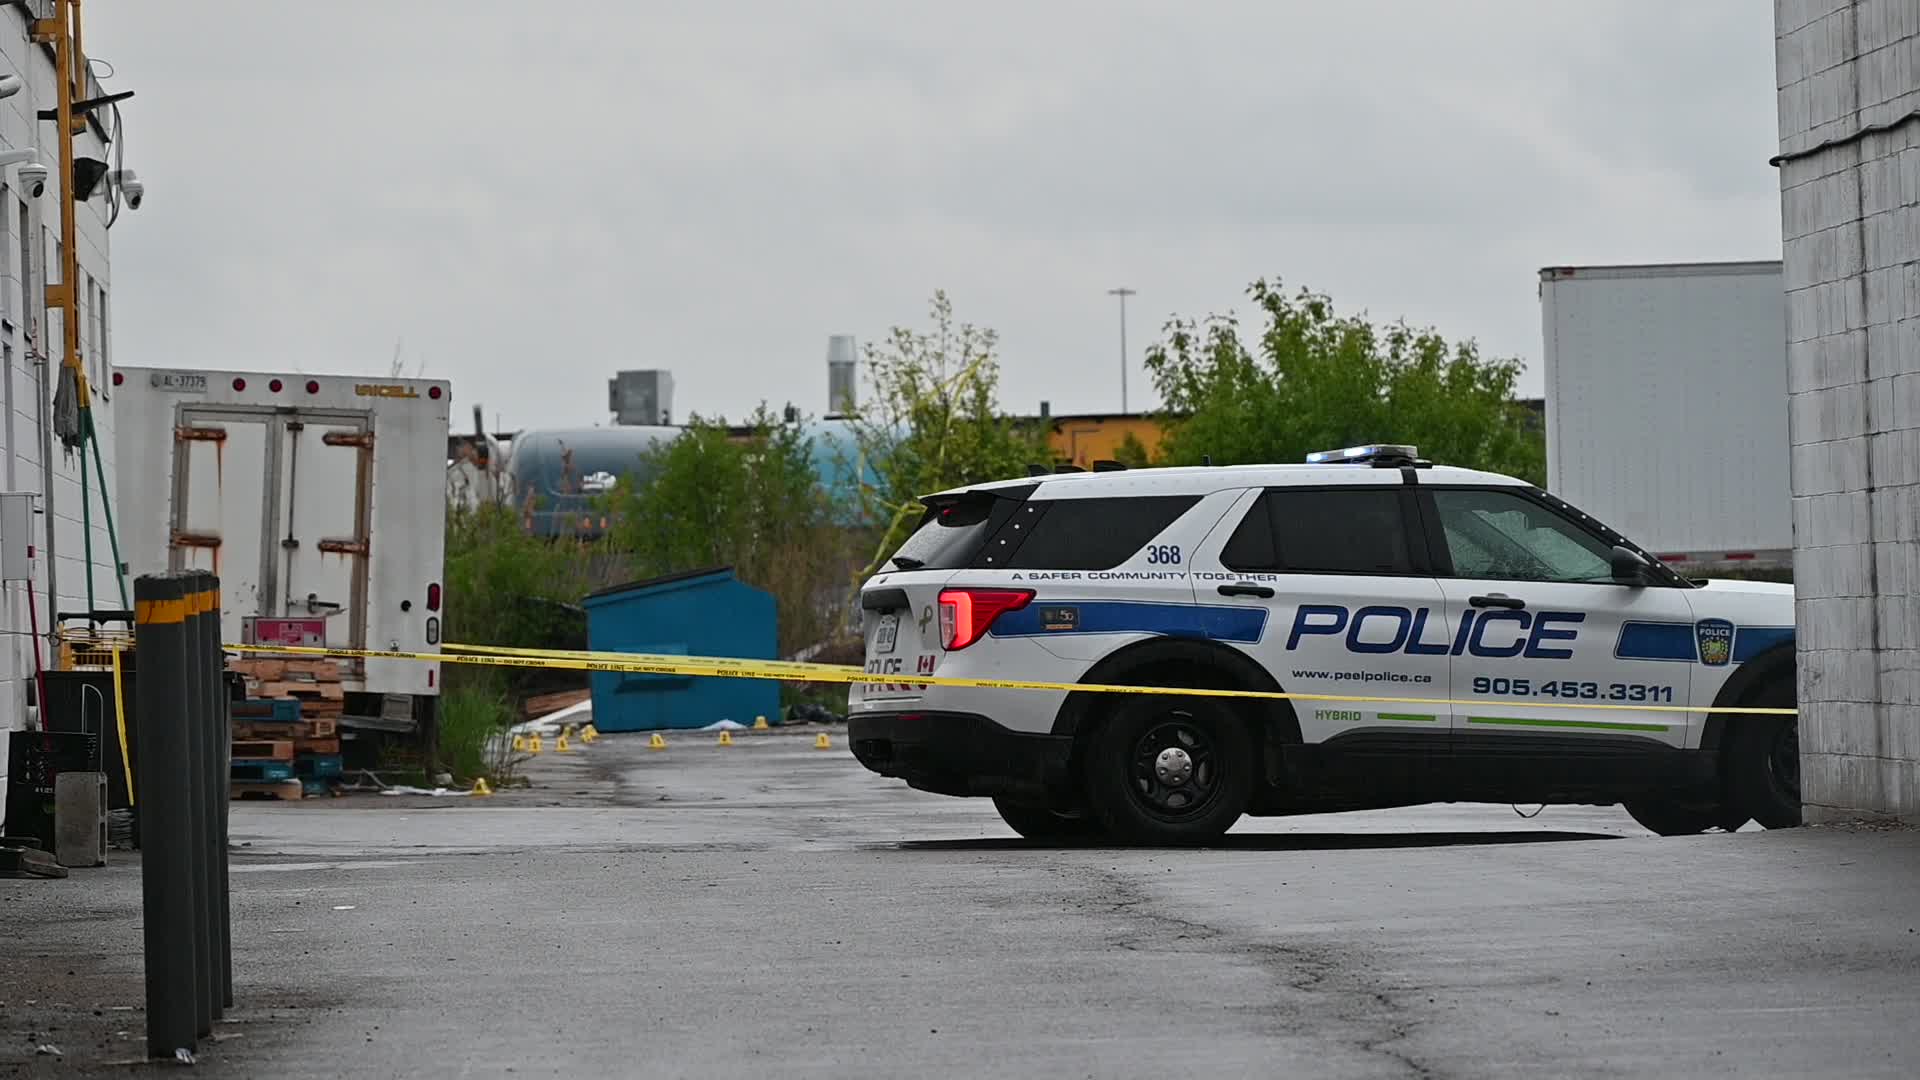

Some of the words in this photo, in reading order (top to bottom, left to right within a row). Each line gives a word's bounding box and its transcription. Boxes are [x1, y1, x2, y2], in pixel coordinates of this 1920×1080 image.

[1147, 545, 1181, 565] 368
[1029, 572, 1082, 580] SAFER
[1088, 572, 1187, 580] COMMUNITY
[1193, 572, 1278, 582] TOGETHER
[1286, 604, 1586, 660] POLICE
[1699, 628, 1730, 637] POLICE
[1292, 669, 1432, 684] www.peelpolice.ca
[1473, 677, 1672, 703] 905.453.3311
[1315, 710, 1362, 721] HYBRID
